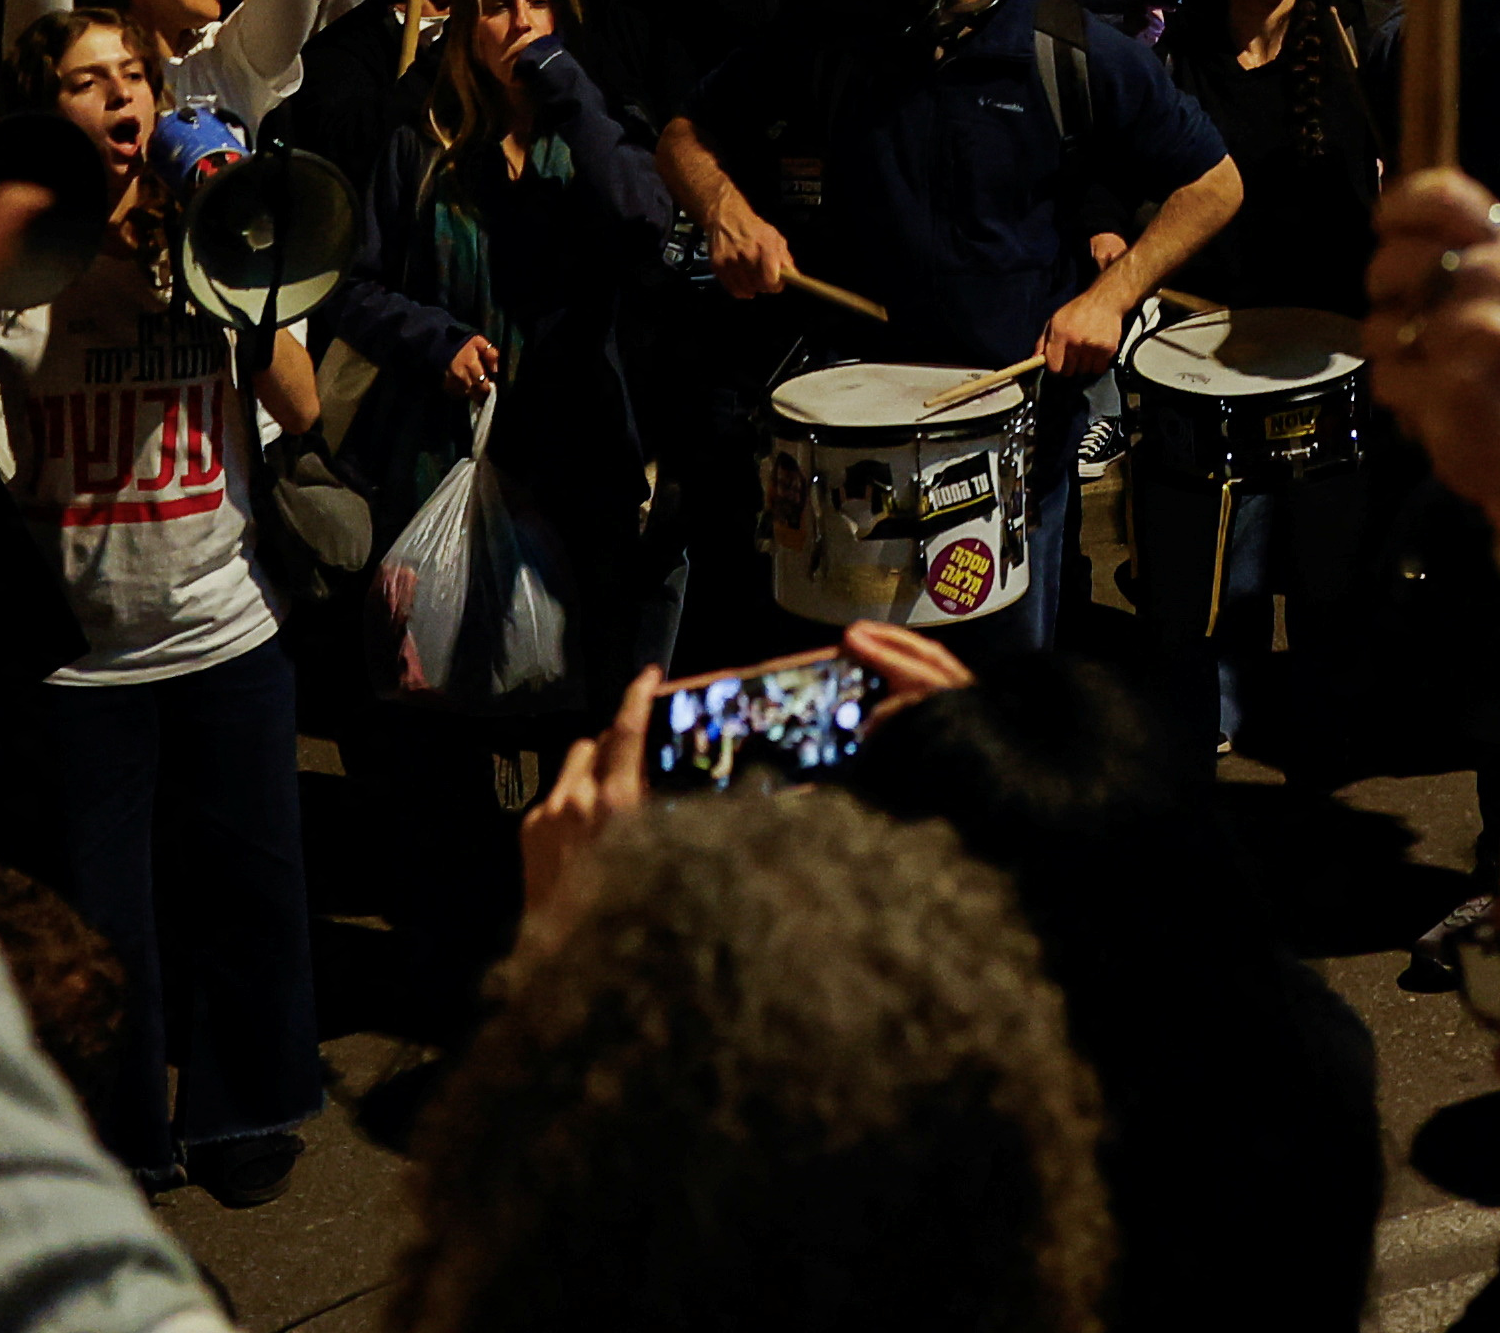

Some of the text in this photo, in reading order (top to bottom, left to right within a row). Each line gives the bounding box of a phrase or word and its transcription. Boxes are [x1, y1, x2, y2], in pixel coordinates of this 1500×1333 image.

[26, 380, 225, 496] עכשיו
[970, 472, 990, 496] עד
[949, 544, 991, 576] עסקה
[940, 563, 984, 596] מלאה
